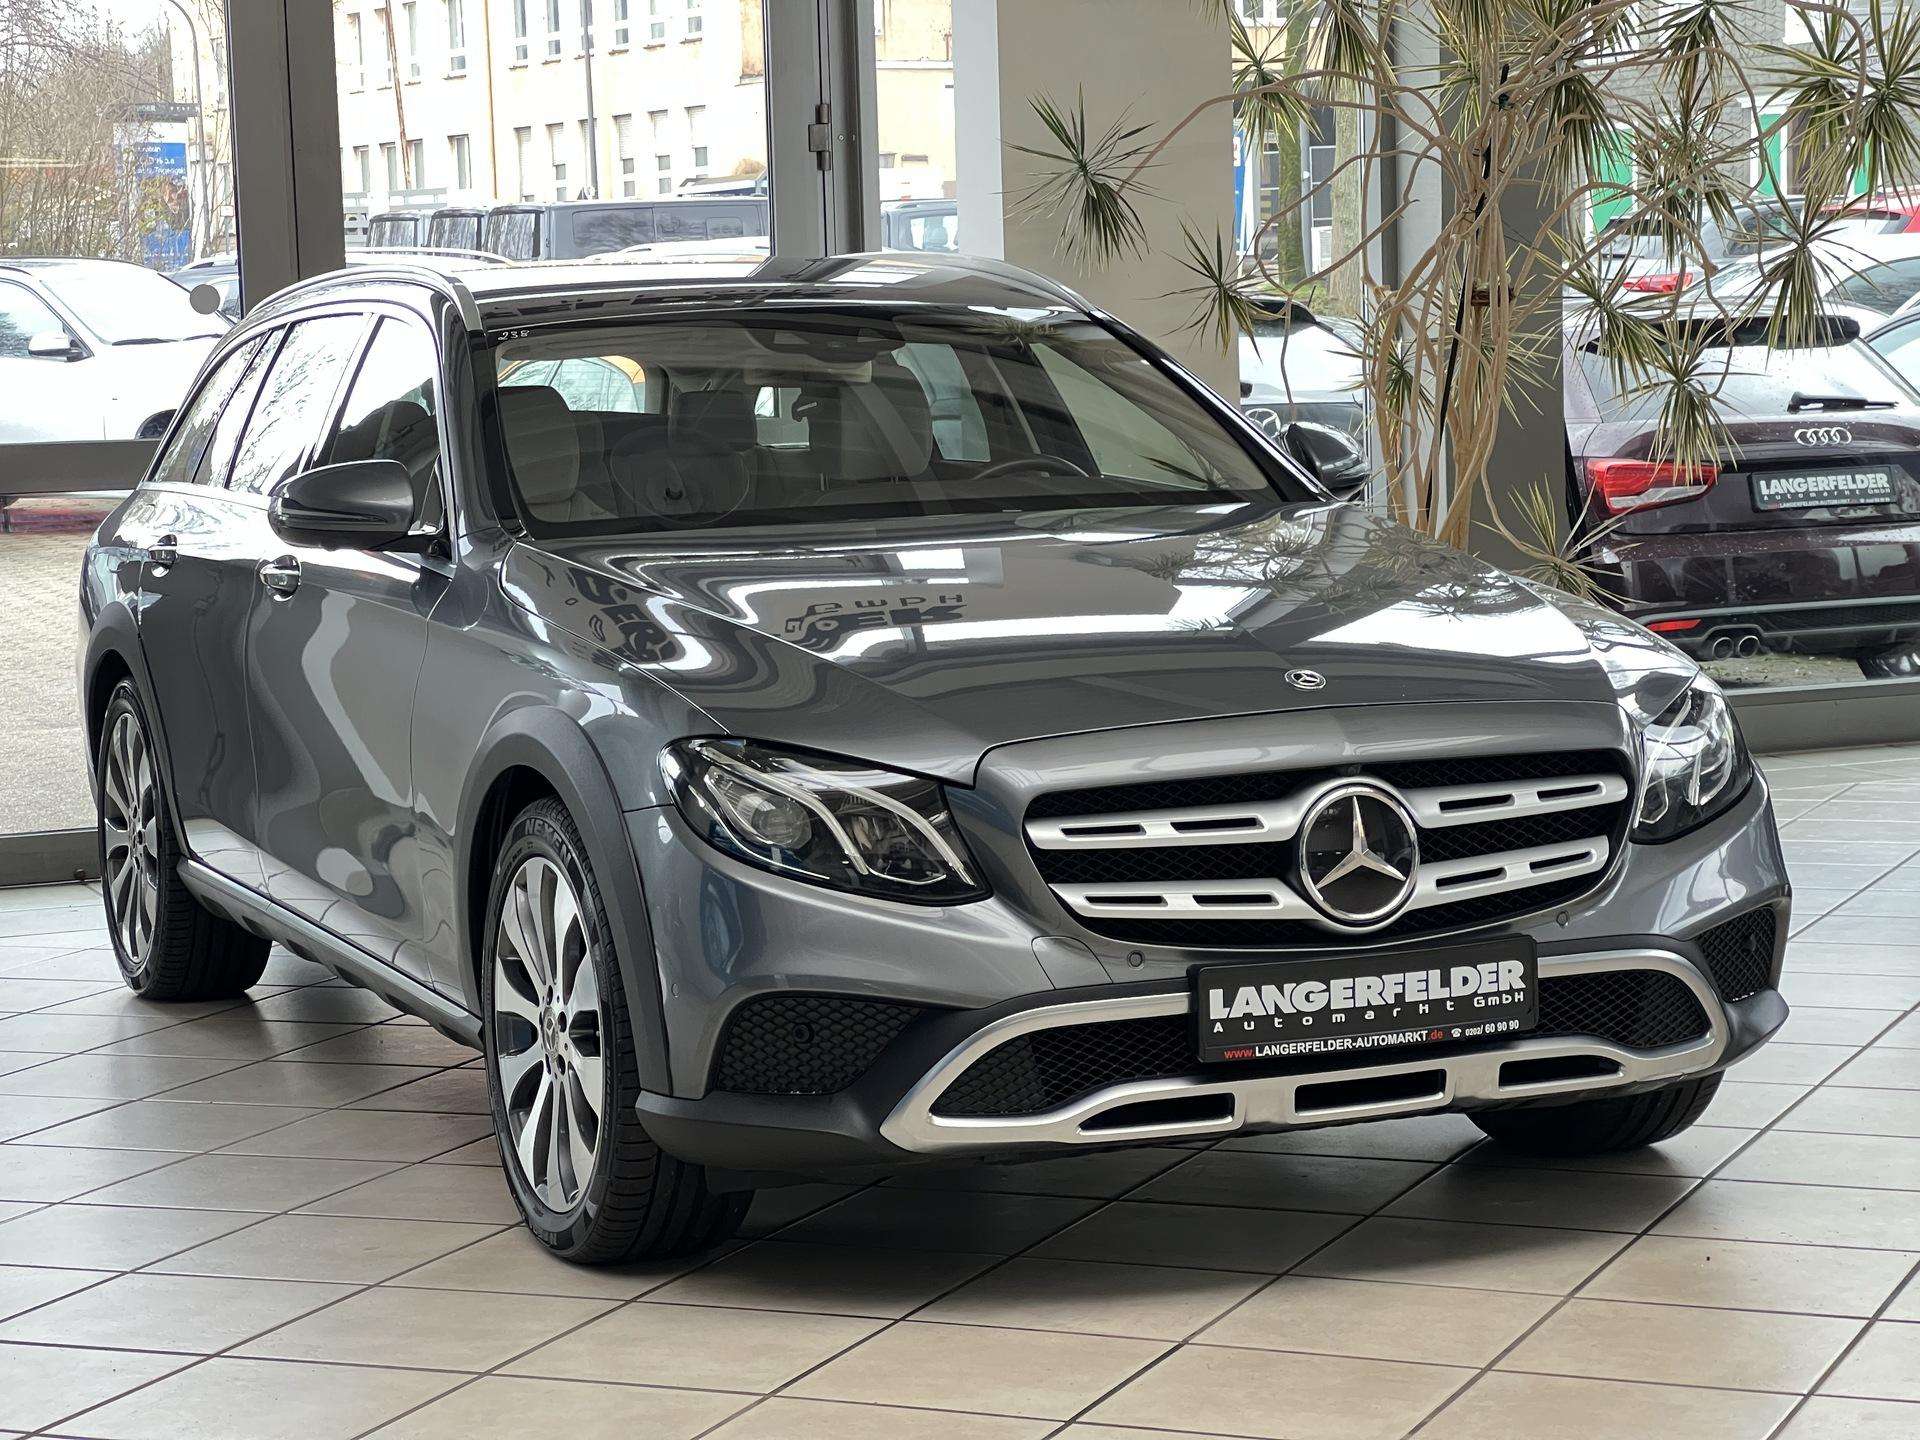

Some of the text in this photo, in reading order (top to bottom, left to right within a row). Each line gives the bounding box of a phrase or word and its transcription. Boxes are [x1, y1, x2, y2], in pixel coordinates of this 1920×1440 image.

[1759, 473, 1889, 495] LANGERFELDER
[525, 818, 571, 868] NEXEN
[1209, 959, 1526, 1019] LANGERFELDER
[1473, 990, 1525, 1008] GmbH
[1224, 1029, 1444, 1060] www.LANGERFELDER-AUTOMARKT.de
[1485, 1023, 1496, 1034] 60
[1497, 1021, 1507, 1032] 90
[1509, 1019, 1520, 1030] 90
